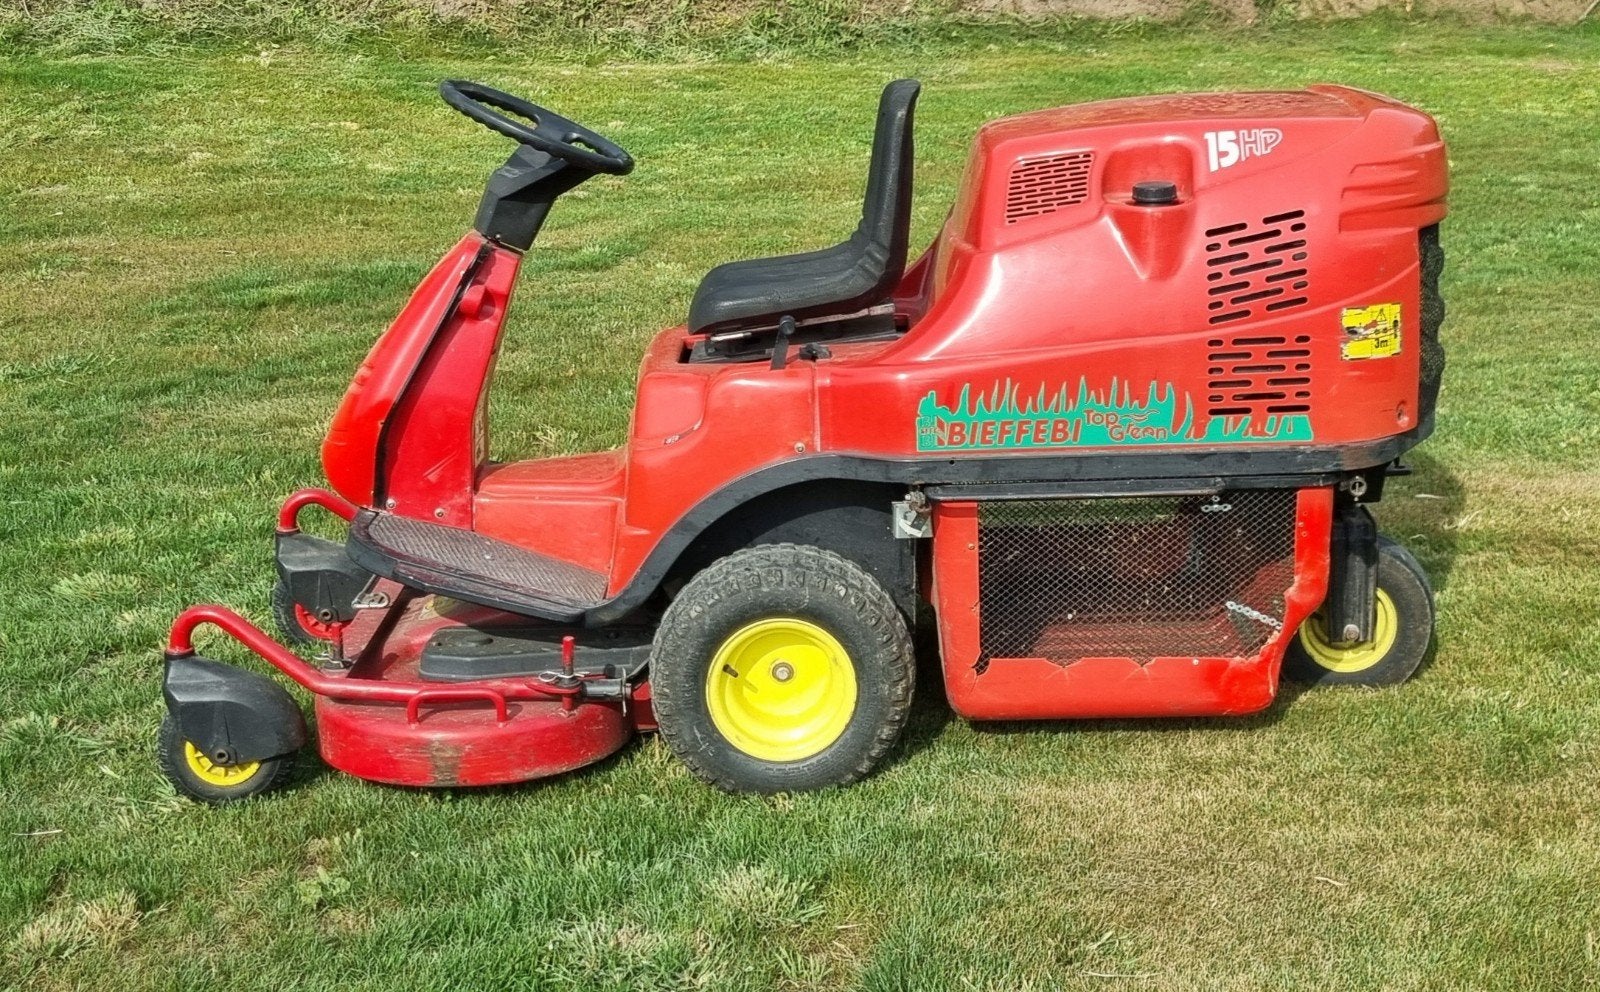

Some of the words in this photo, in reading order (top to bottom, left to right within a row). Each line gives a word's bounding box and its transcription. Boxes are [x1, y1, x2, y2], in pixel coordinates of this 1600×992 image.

[1084, 408, 1119, 428] Top
[947, 418, 1082, 446] BIEFFEBI
[1108, 422, 1167, 441] Green
